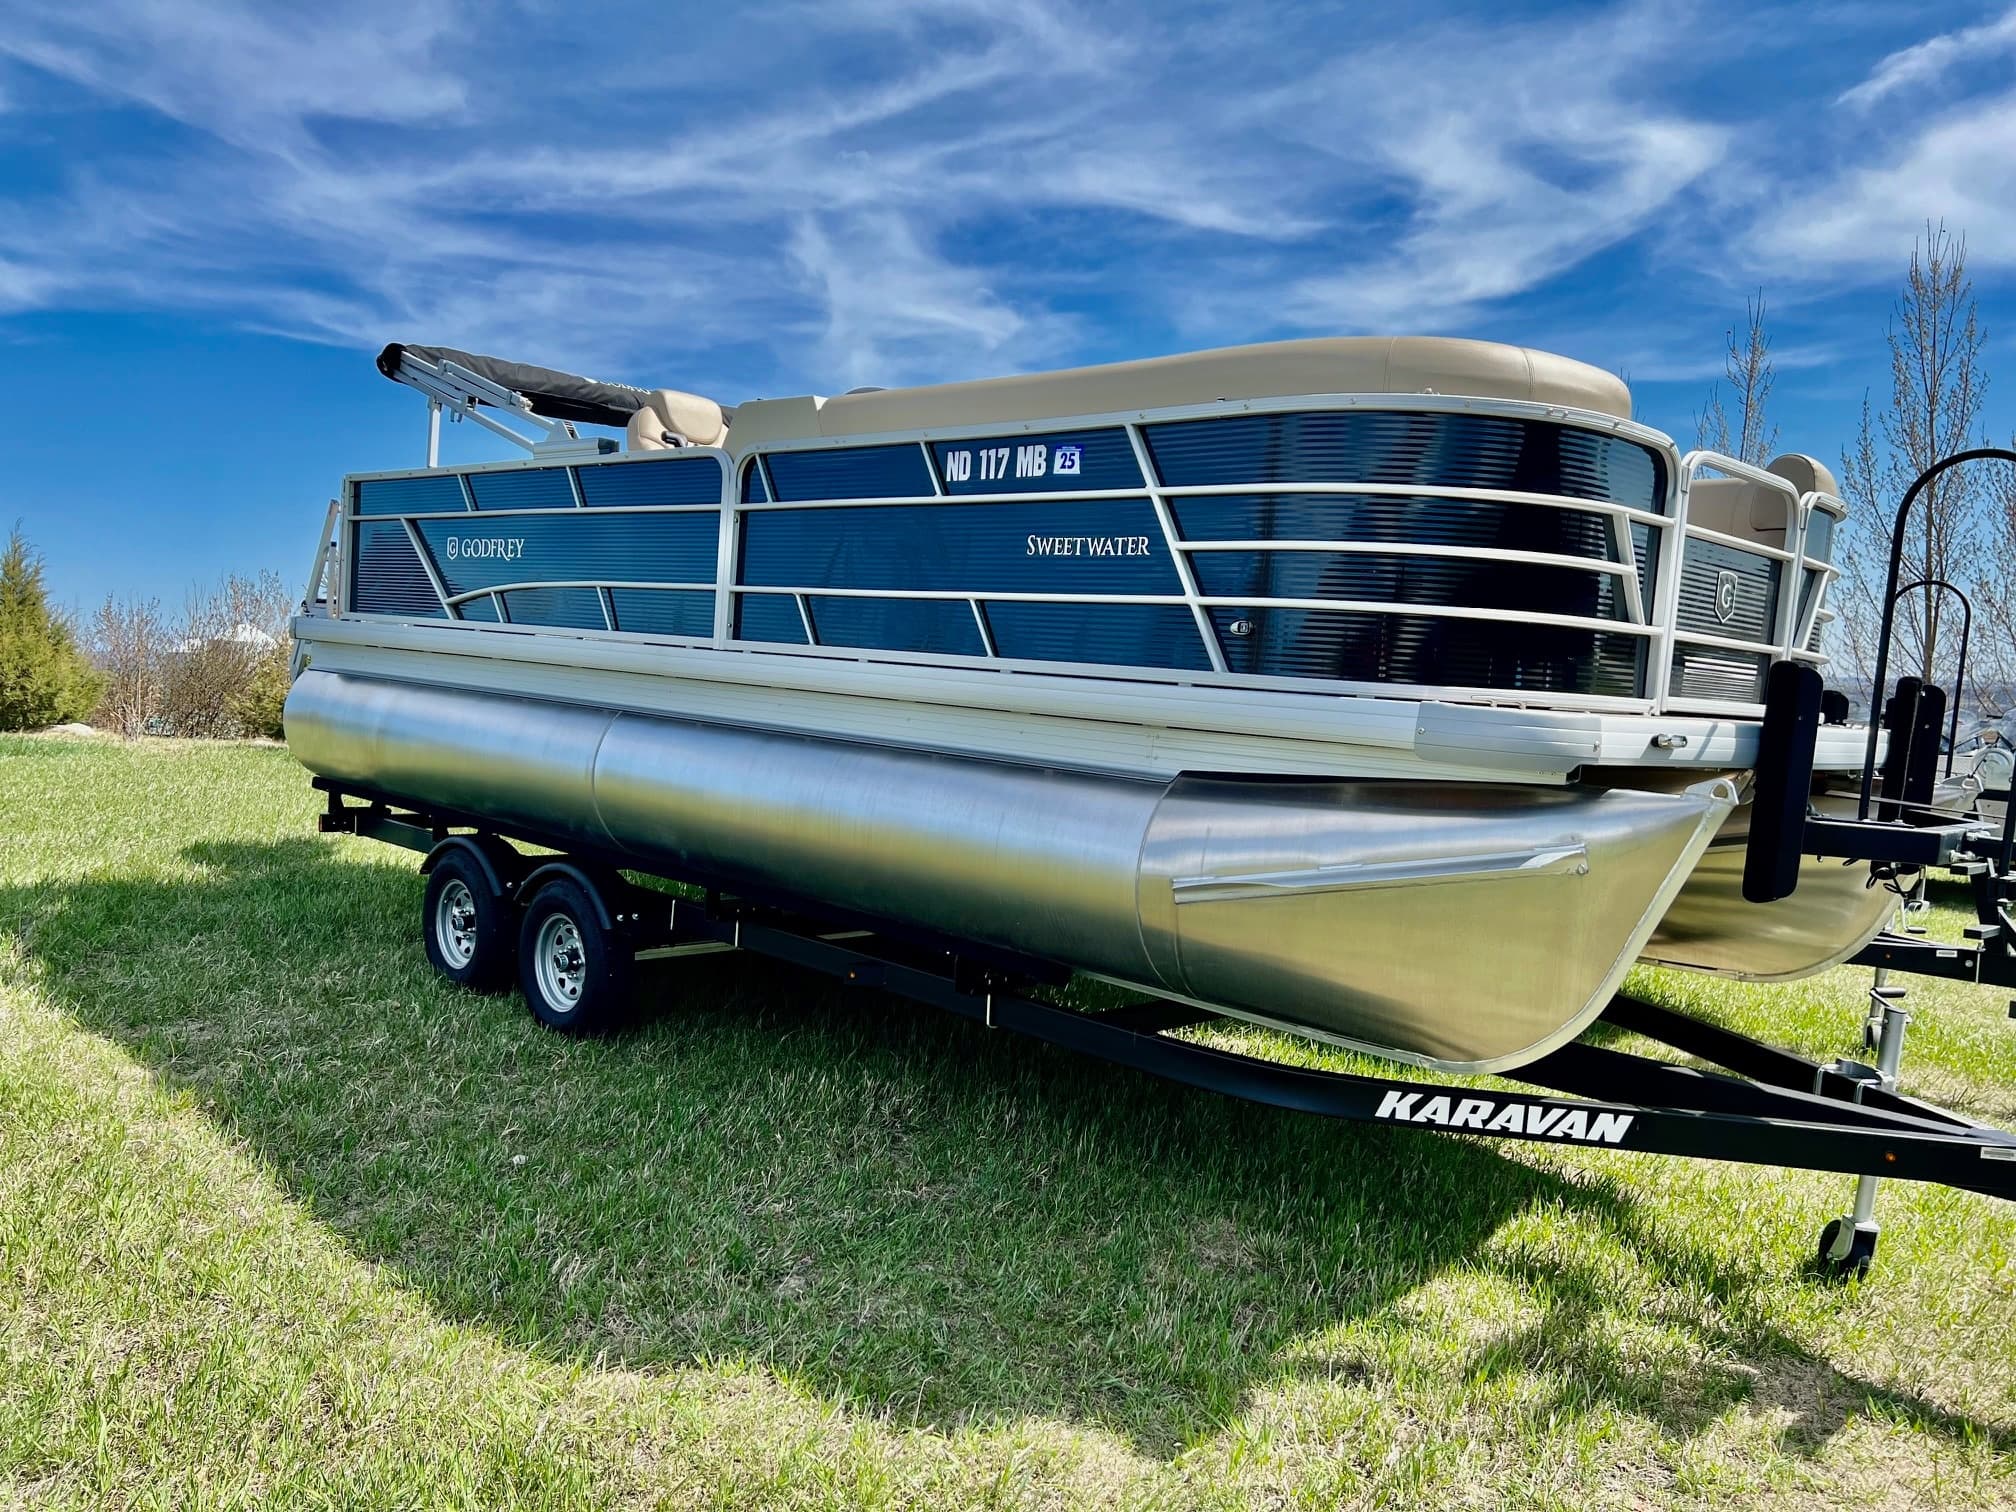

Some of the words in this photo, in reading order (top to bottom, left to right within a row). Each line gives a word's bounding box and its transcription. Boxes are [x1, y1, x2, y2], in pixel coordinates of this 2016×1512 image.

[946, 450, 972, 482] ND
[979, 447, 1010, 480] 117
[1015, 444, 1047, 478] MB
[1059, 452, 1076, 470] 25
[461, 538, 525, 561] GODFREY
[1026, 534, 1150, 557] SWEETWATER
[1721, 583, 1732, 609] G
[1374, 1090, 1634, 1144] KARAVAN
